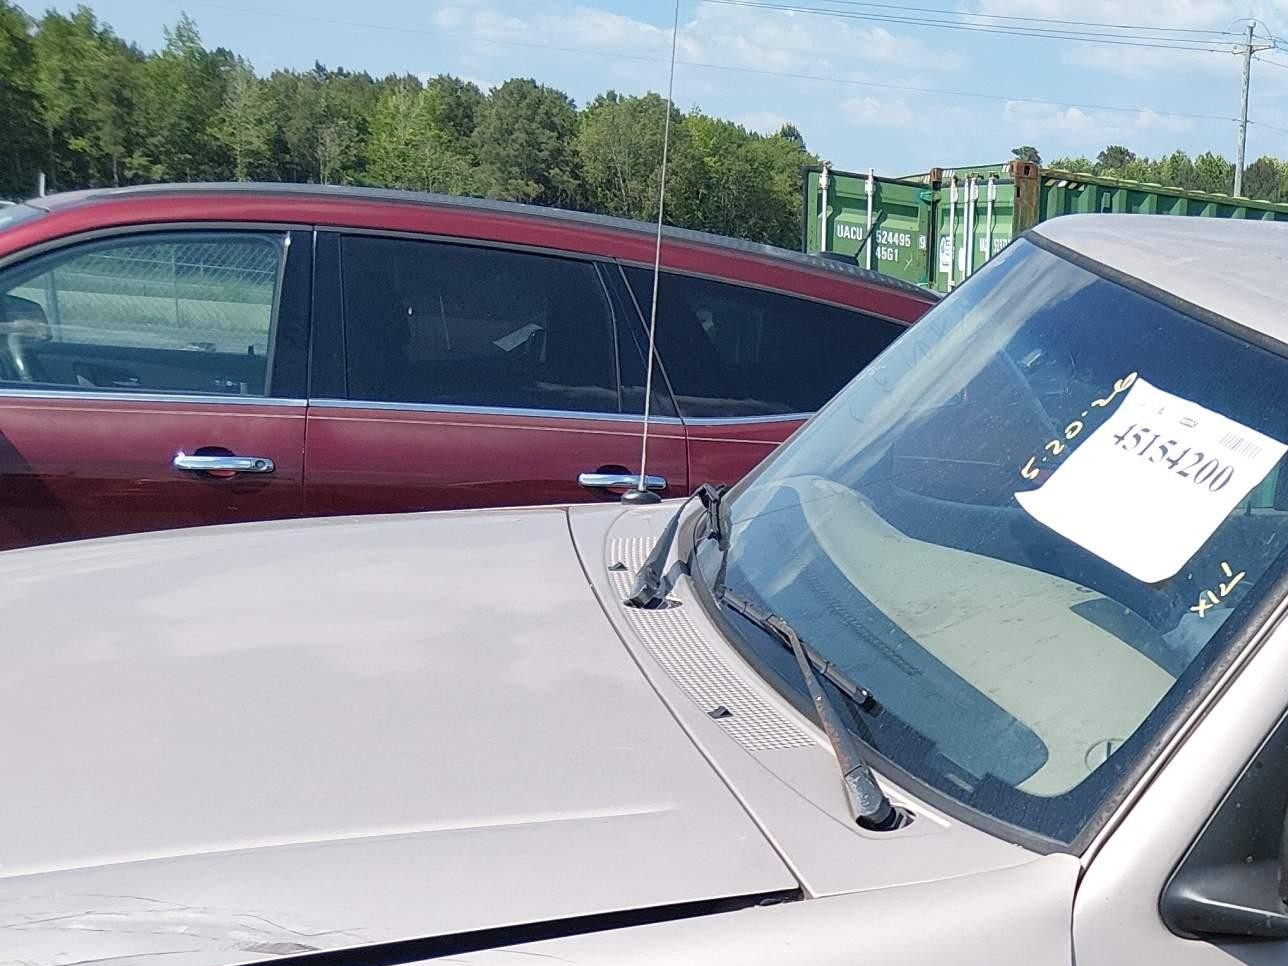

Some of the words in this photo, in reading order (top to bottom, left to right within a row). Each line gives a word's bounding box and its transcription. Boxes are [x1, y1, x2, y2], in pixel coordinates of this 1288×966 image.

[837, 223, 863, 240] UACU
[875, 230, 911, 247] 524495
[919, 234, 927, 250] 9
[875, 245, 899, 262] 45G1
[1113, 423, 1235, 493] 45154200
